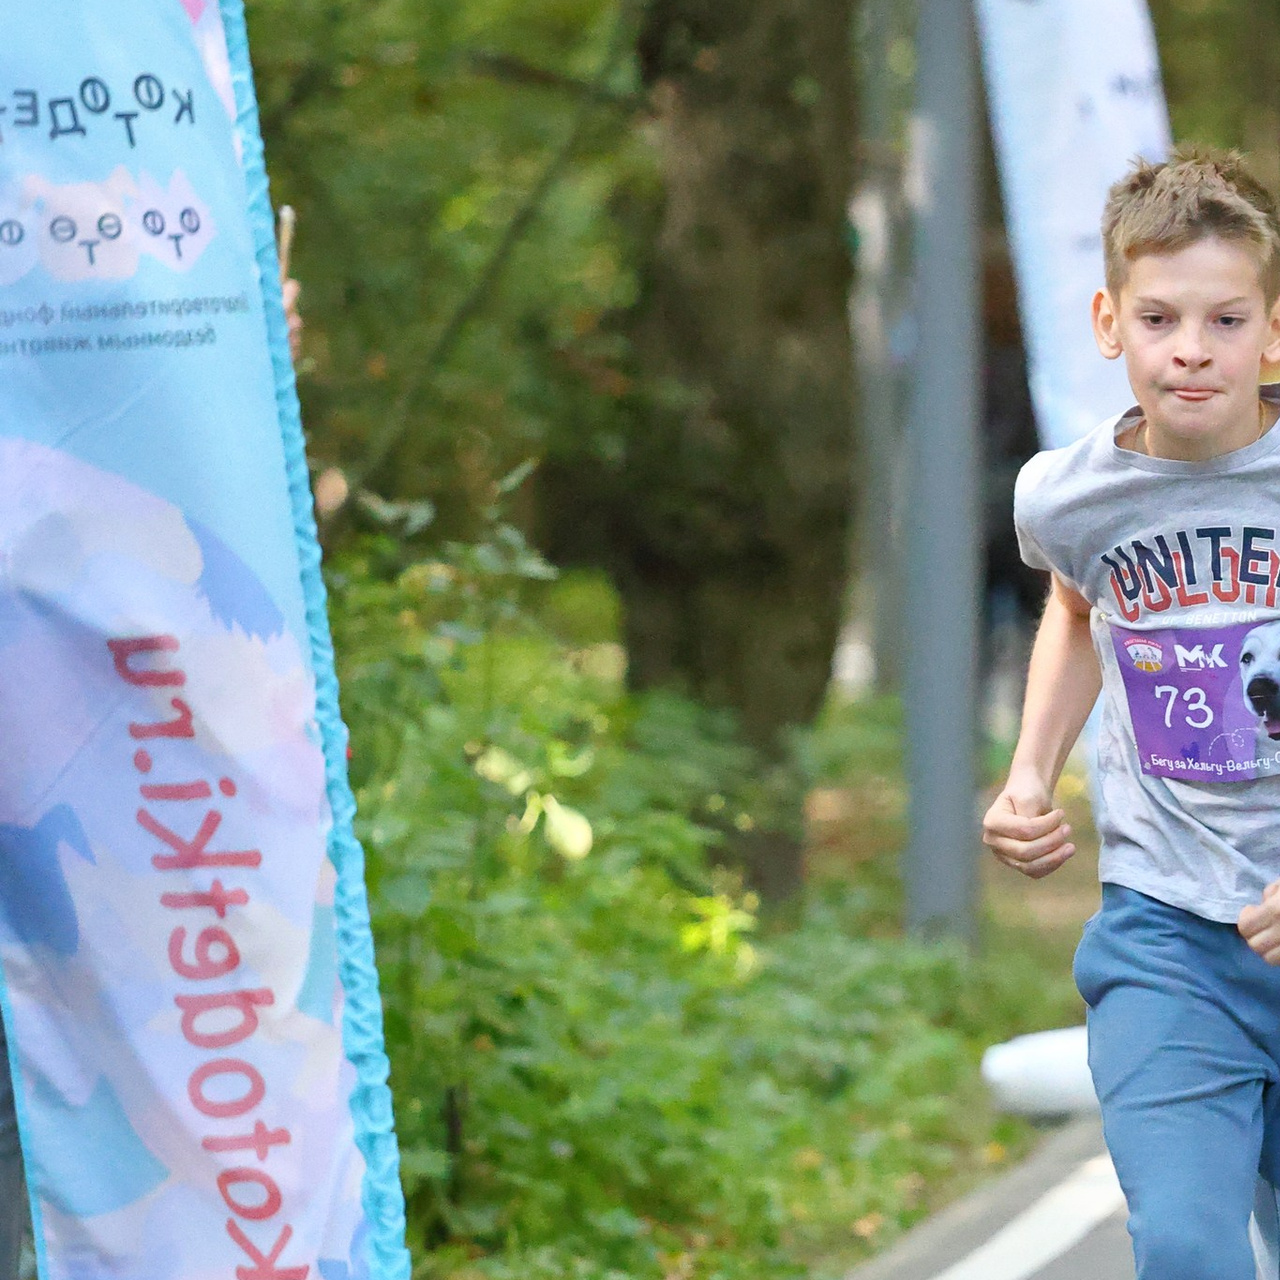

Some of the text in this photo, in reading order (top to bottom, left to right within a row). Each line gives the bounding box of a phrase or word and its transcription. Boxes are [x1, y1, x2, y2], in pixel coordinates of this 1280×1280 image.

[1153, 685, 1214, 729] 73
[1150, 754, 1173, 771] Бегу
[1174, 759, 1187, 770] за
